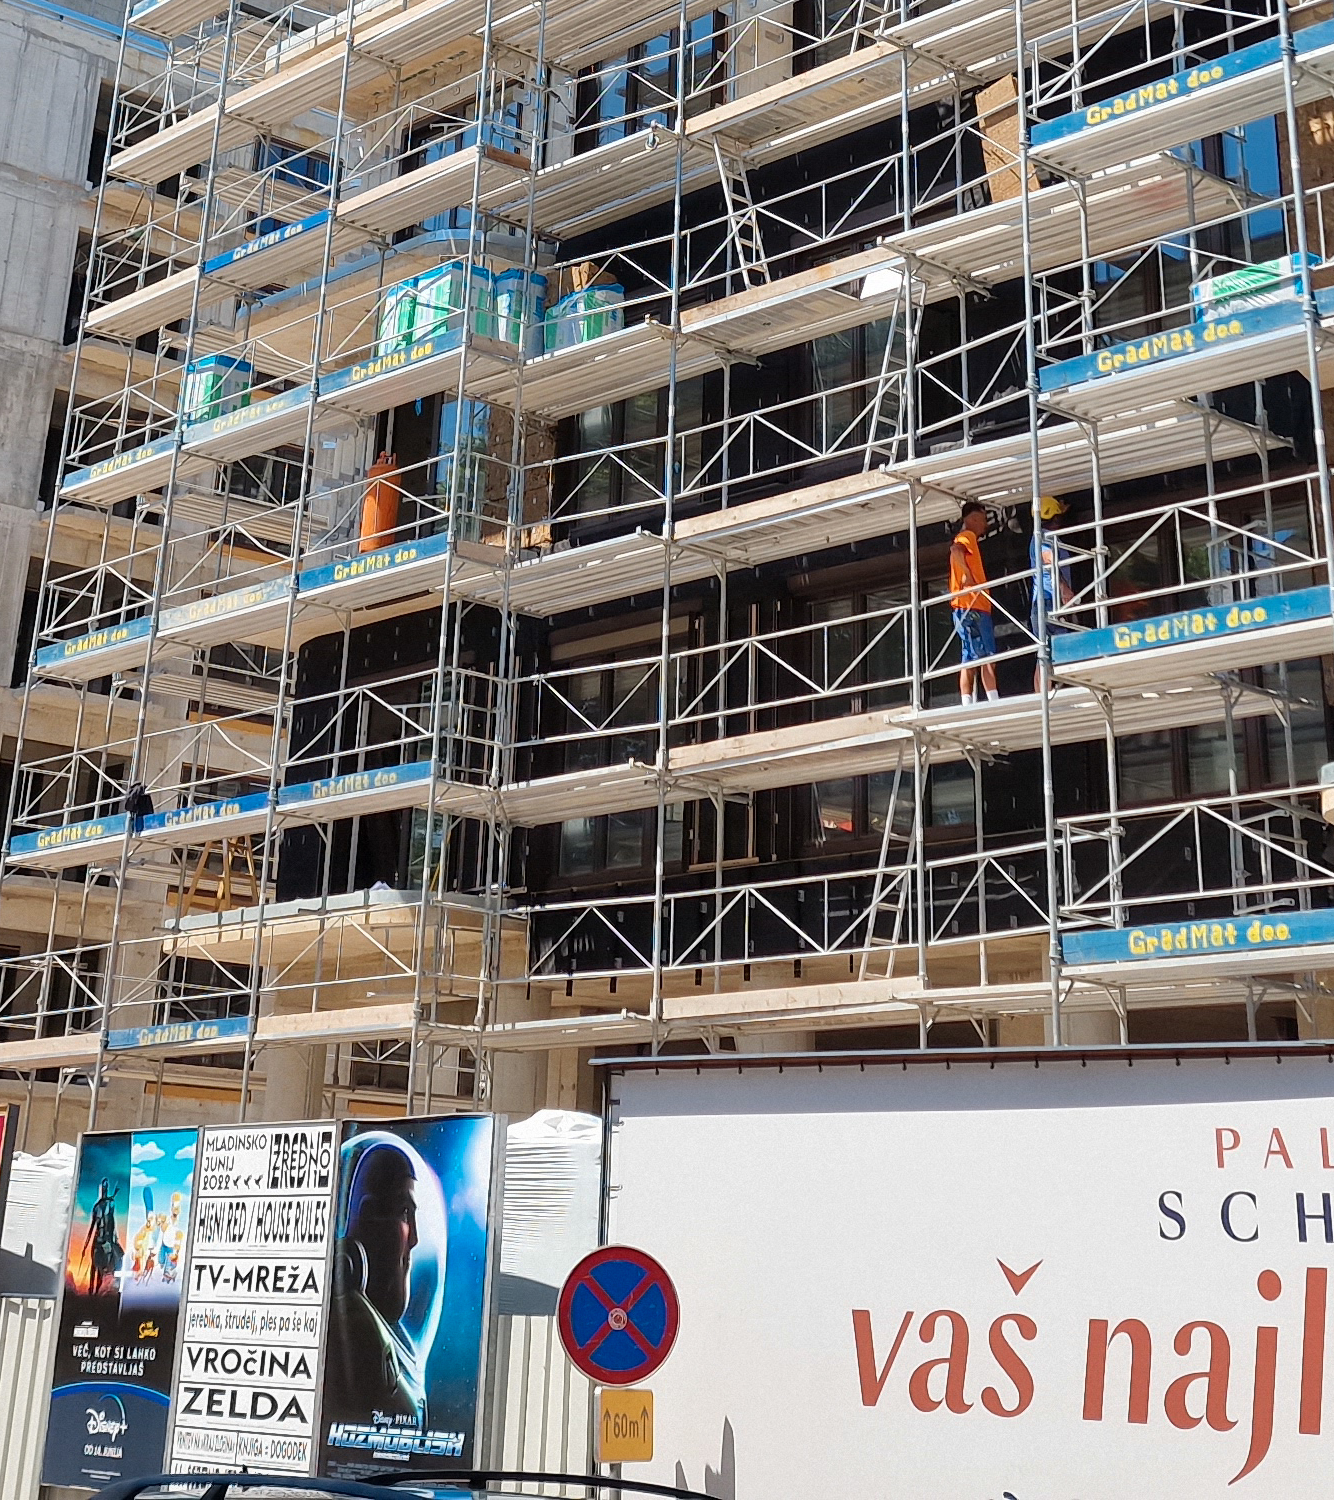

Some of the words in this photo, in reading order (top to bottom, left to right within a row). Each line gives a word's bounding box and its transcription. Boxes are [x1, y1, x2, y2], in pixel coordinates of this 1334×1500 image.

[1087, 79, 1179, 125] GradMat
[1097, 329, 1195, 372] GradMat
[1115, 610, 1219, 649] GradMat
[1127, 922, 1237, 955] GradMat
[205, 1133, 268, 1153] MLADINSKO
[204, 1155, 235, 1173] JUNIJ
[267, 1131, 333, 1190] IZREDNO
[202, 1174, 231, 1191] 2022
[225, 1201, 247, 1244] RED
[255, 1200, 293, 1244] HOUSE
[292, 1199, 327, 1244] RULES
[259, 1311, 278, 1334] ples
[278, 1314, 291, 1334] pa
[303, 1310, 319, 1338] kaj
[851, 1257, 1044, 1419] vaš
[94, 1345, 112, 1359] KOT
[113, 1346, 126, 1360] SI
[126, 1347, 157, 1361] LAHKO
[181, 1386, 309, 1424] ZELDA
[613, 1412, 640, 1440] 60m
[238, 1435, 263, 1458] KNJIGA
[270, 1439, 308, 1462] DOGODEK
